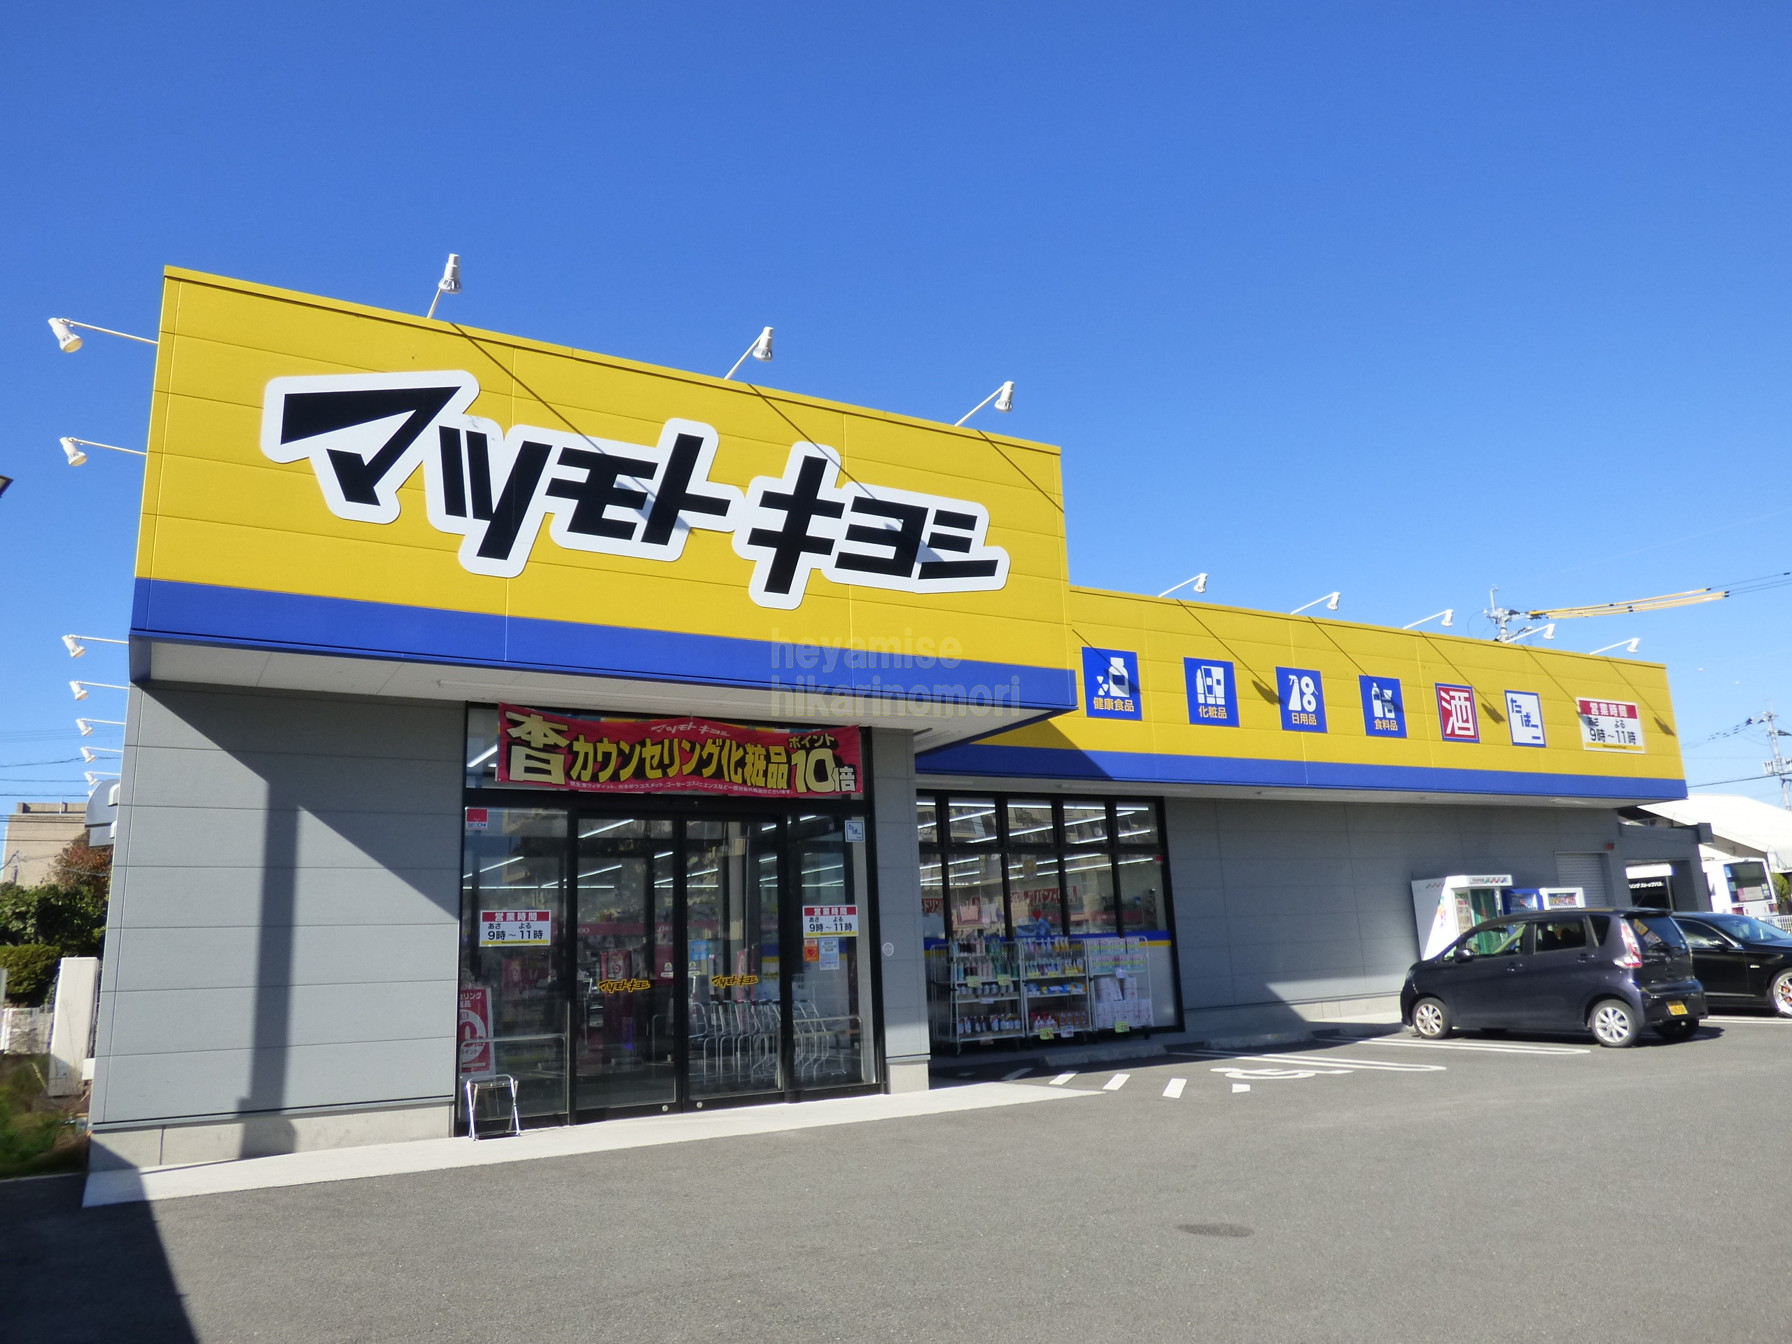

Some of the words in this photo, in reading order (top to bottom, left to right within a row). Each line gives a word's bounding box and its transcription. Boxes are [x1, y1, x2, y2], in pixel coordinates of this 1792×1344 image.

[279, 384, 1001, 596] マツモトキヨシ
[1093, 696, 1135, 712] 健康食品
[1589, 702, 1628, 718] 営業時間
[1198, 707, 1228, 719] 化粧品
[1291, 713, 1317, 726] 日用品
[1440, 690, 1475, 736] 酒
[1510, 697, 1541, 740] たばこ
[651, 722, 730, 737] マツモトキヨシ
[1374, 718, 1398, 731] 食料品
[505, 711, 570, 785] 本日
[788, 732, 835, 749] ポイント
[494, 911, 538, 922] 営業時間
[813, 906, 848, 916] 営業時間
[487, 922, 501, 930] あさ
[518, 922, 532, 930] よる
